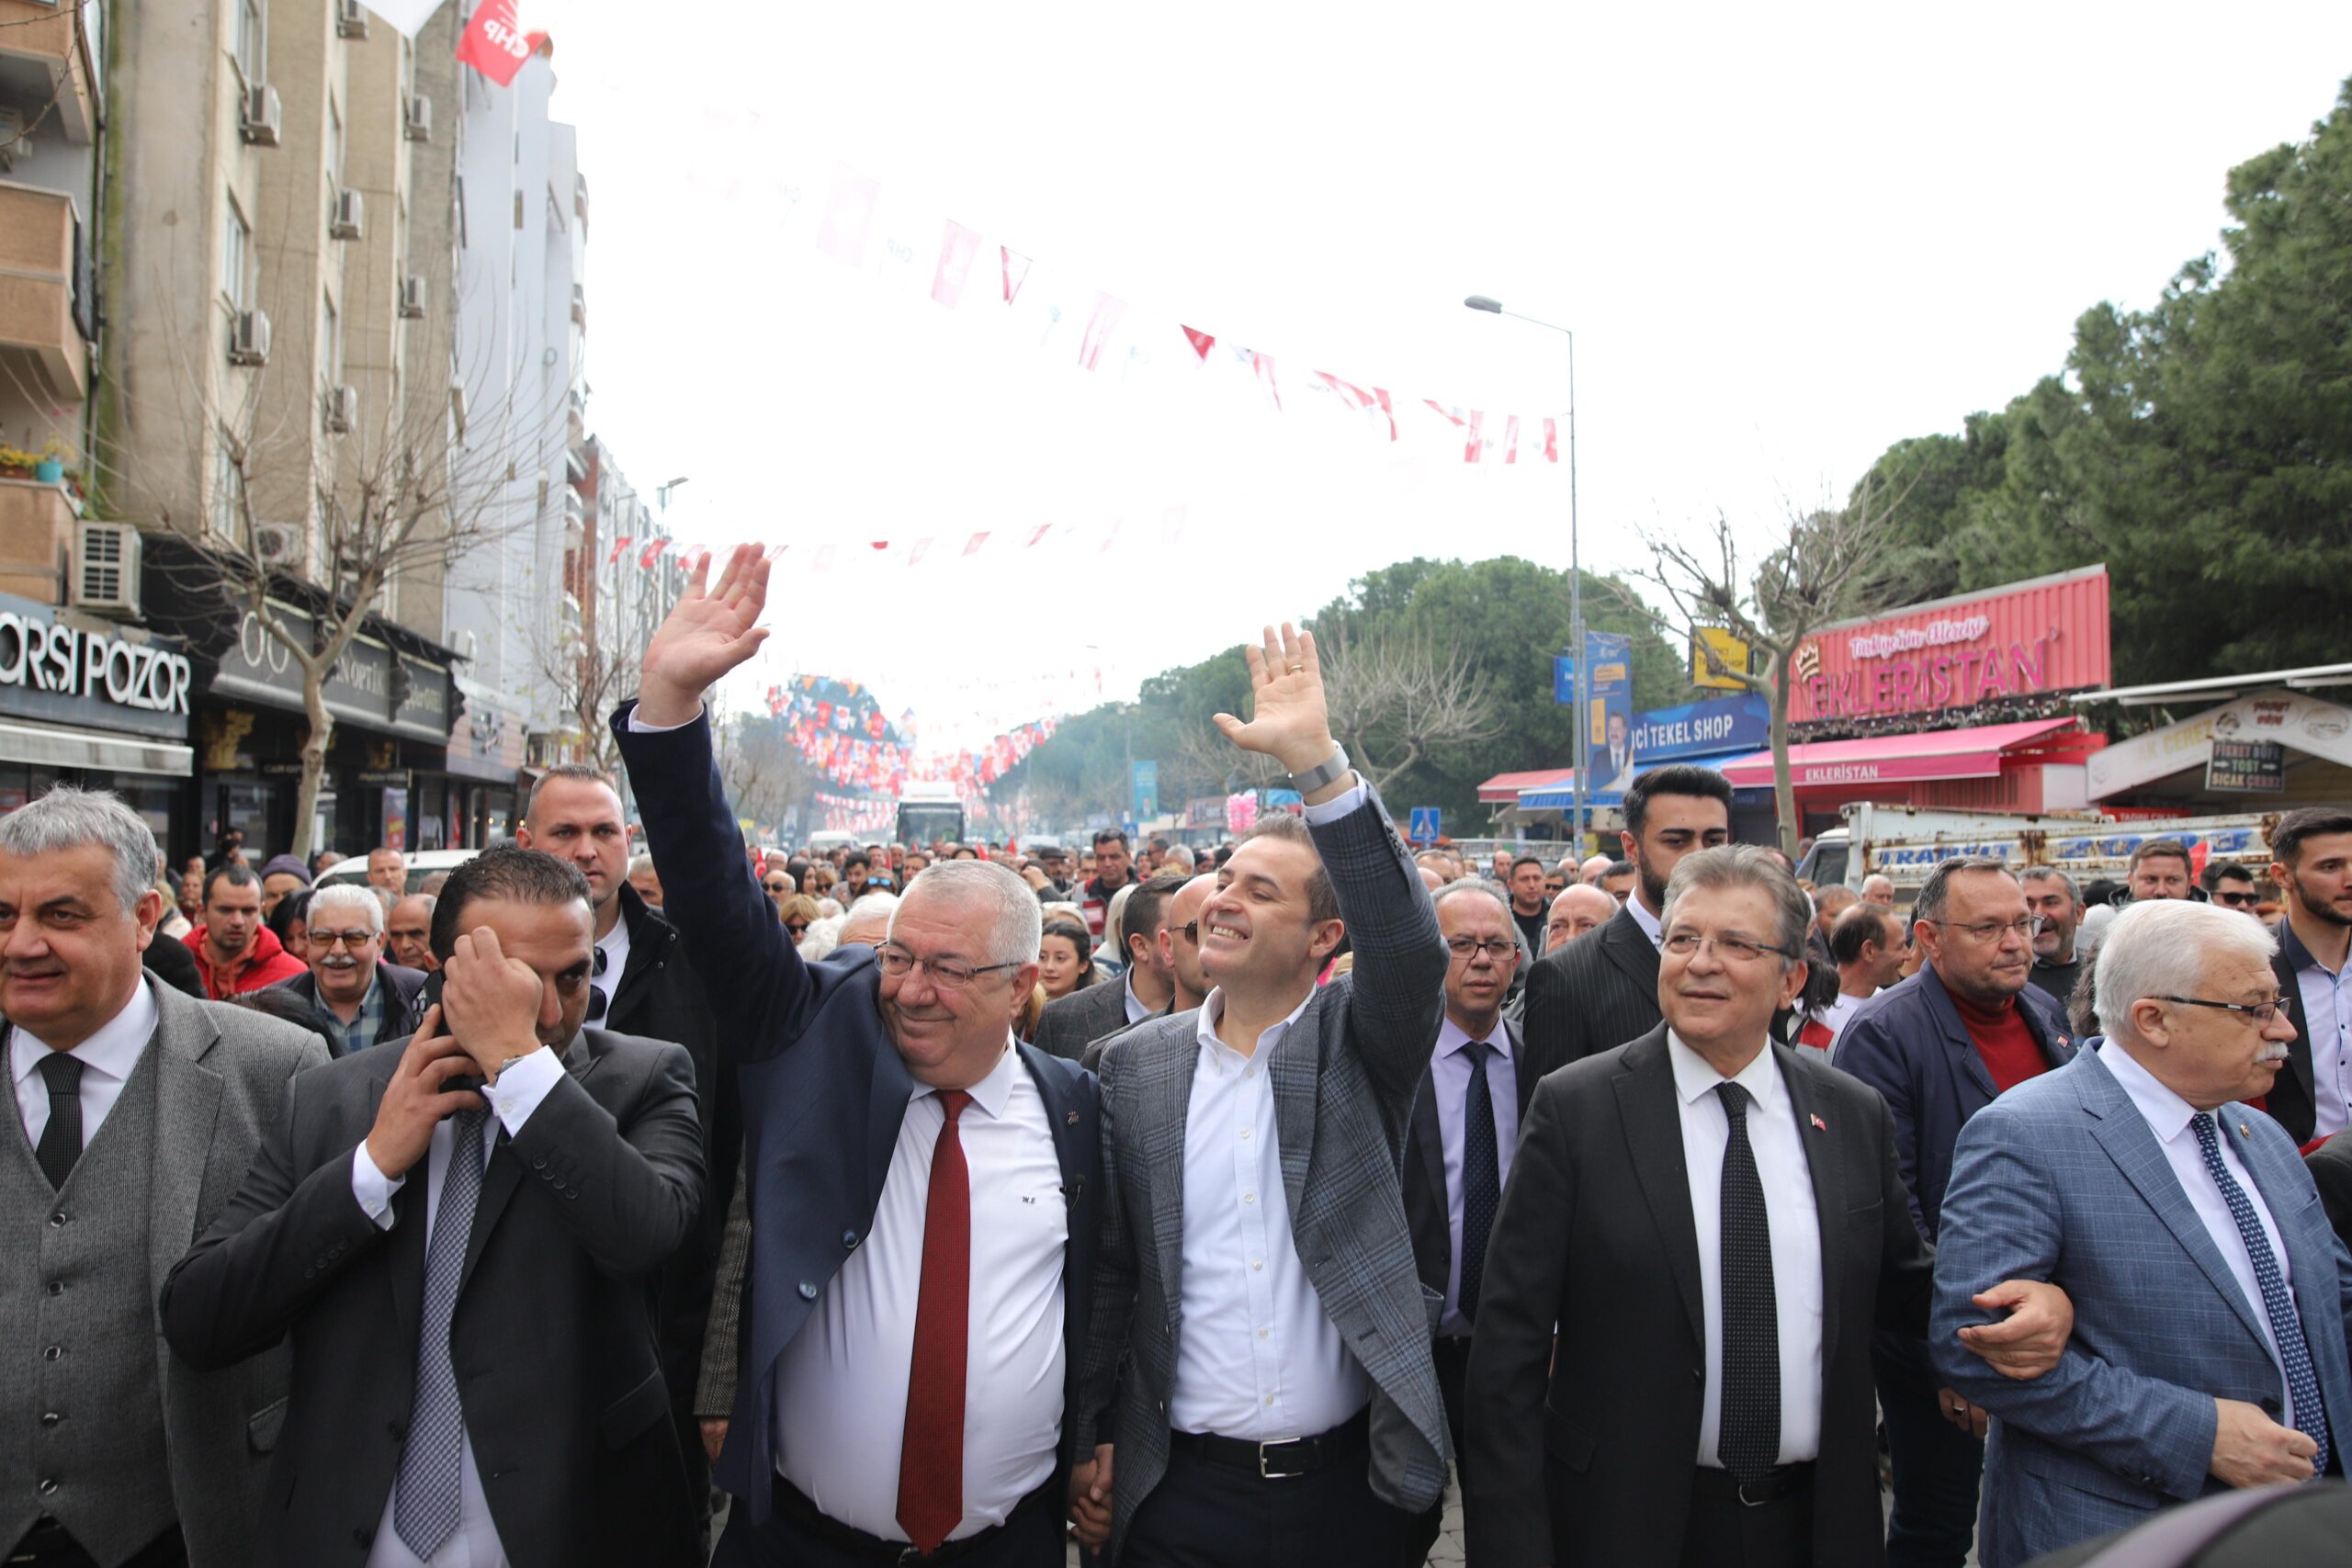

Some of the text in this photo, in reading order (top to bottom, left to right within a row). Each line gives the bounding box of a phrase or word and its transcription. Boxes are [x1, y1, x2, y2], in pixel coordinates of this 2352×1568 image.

[1650, 721, 1690, 747] TEKEL
[1693, 714, 1733, 741] SHOP
[1805, 763, 1878, 781] EKLERİSTAN
[2232, 760, 2259, 773] TOST
[2211, 772, 2245, 787] SICAK
